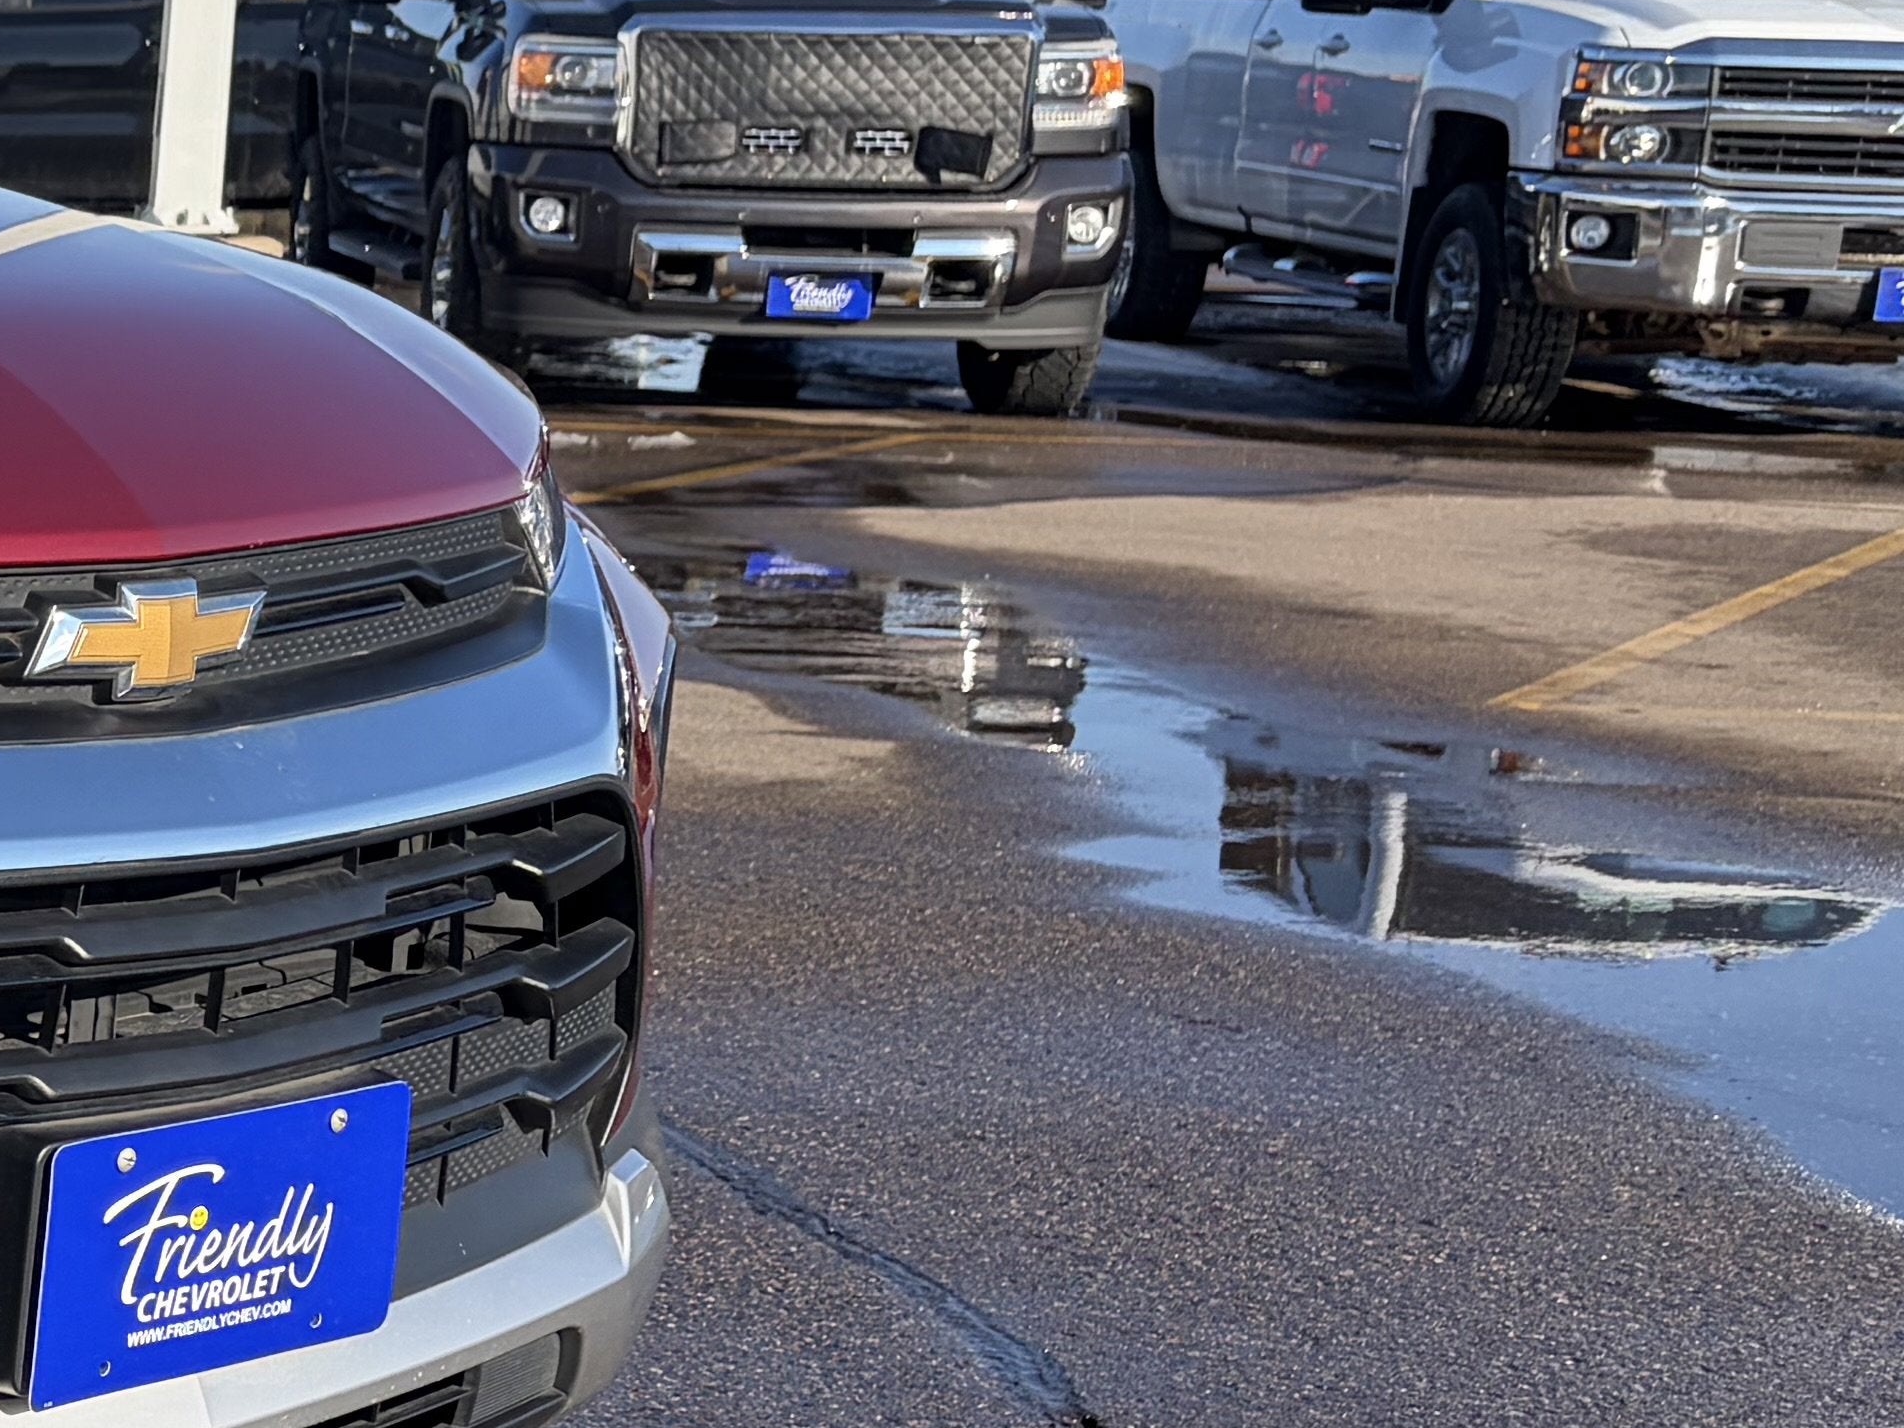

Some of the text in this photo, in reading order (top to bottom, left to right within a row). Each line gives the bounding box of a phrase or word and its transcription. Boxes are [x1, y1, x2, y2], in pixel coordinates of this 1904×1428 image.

[103, 1163, 334, 1305] Friendly
[127, 1298, 293, 1348] WWW.FRIENDLYCHEV.COM
[136, 1265, 287, 1323] CHEVROLET
